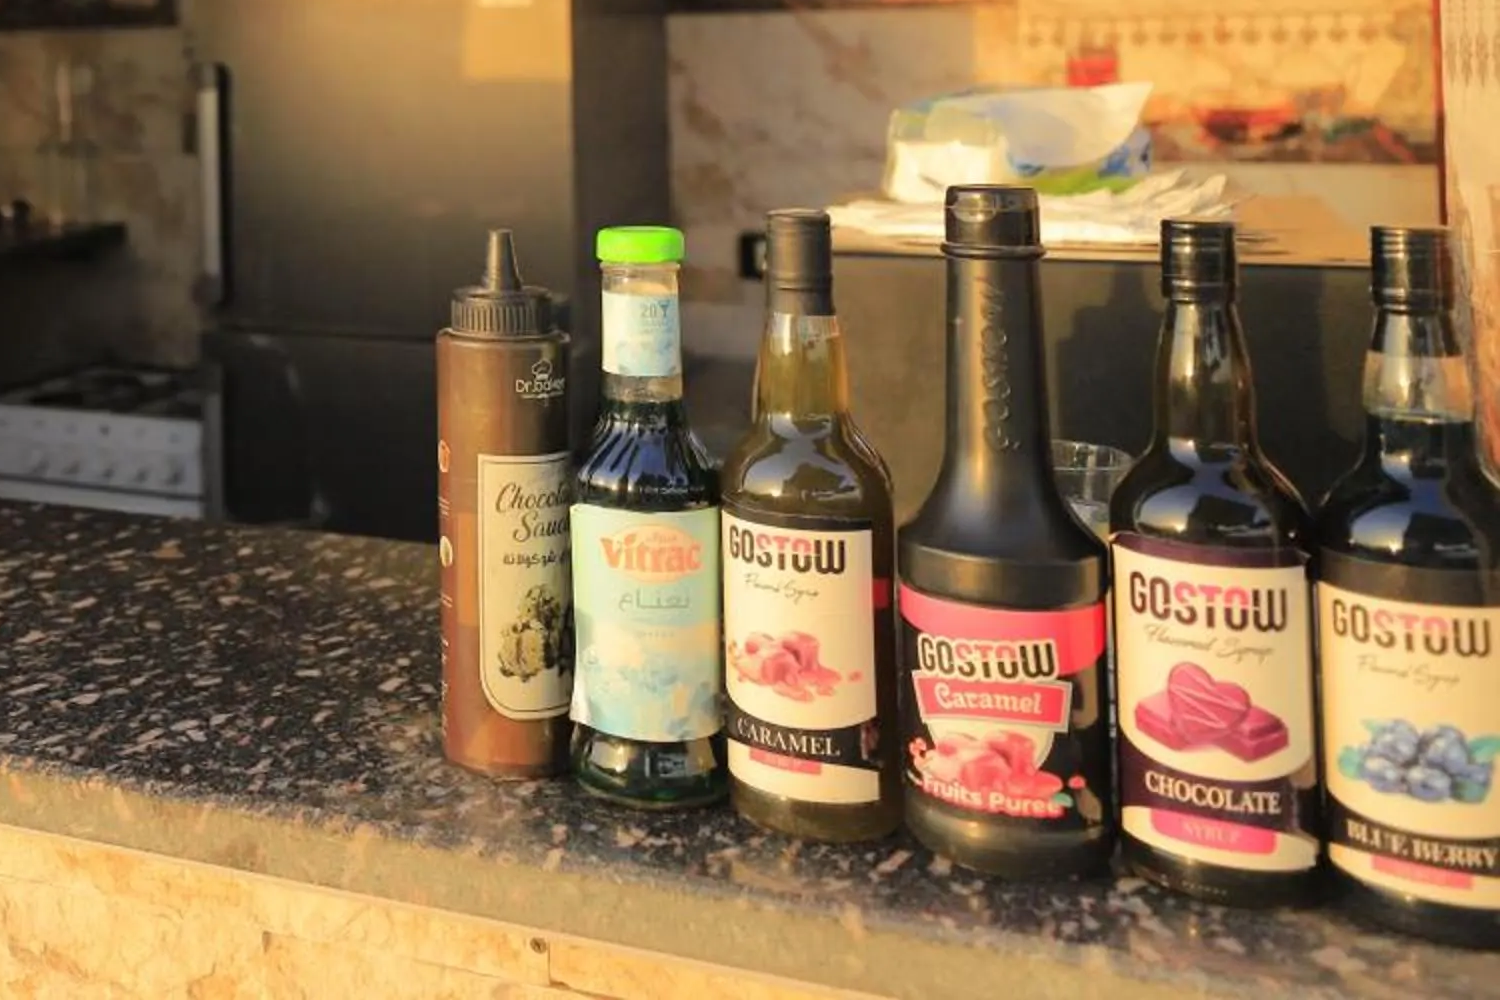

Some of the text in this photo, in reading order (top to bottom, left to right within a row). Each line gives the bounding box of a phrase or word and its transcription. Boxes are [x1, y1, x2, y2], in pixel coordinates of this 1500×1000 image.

[495, 481, 568, 514] Chocol
[600, 533, 704, 574] Vitrac
[729, 524, 846, 575] GOSTOW
[1130, 571, 1287, 632] GOSTOW
[1333, 598, 1492, 658] GOSTOW
[920, 636, 1056, 678] GOSTOW
[934, 681, 1042, 715] Caramel
[737, 717, 841, 757] CARAMEL
[922, 773, 983, 808] Fruits
[1145, 770, 1282, 815] CHOCOLATE
